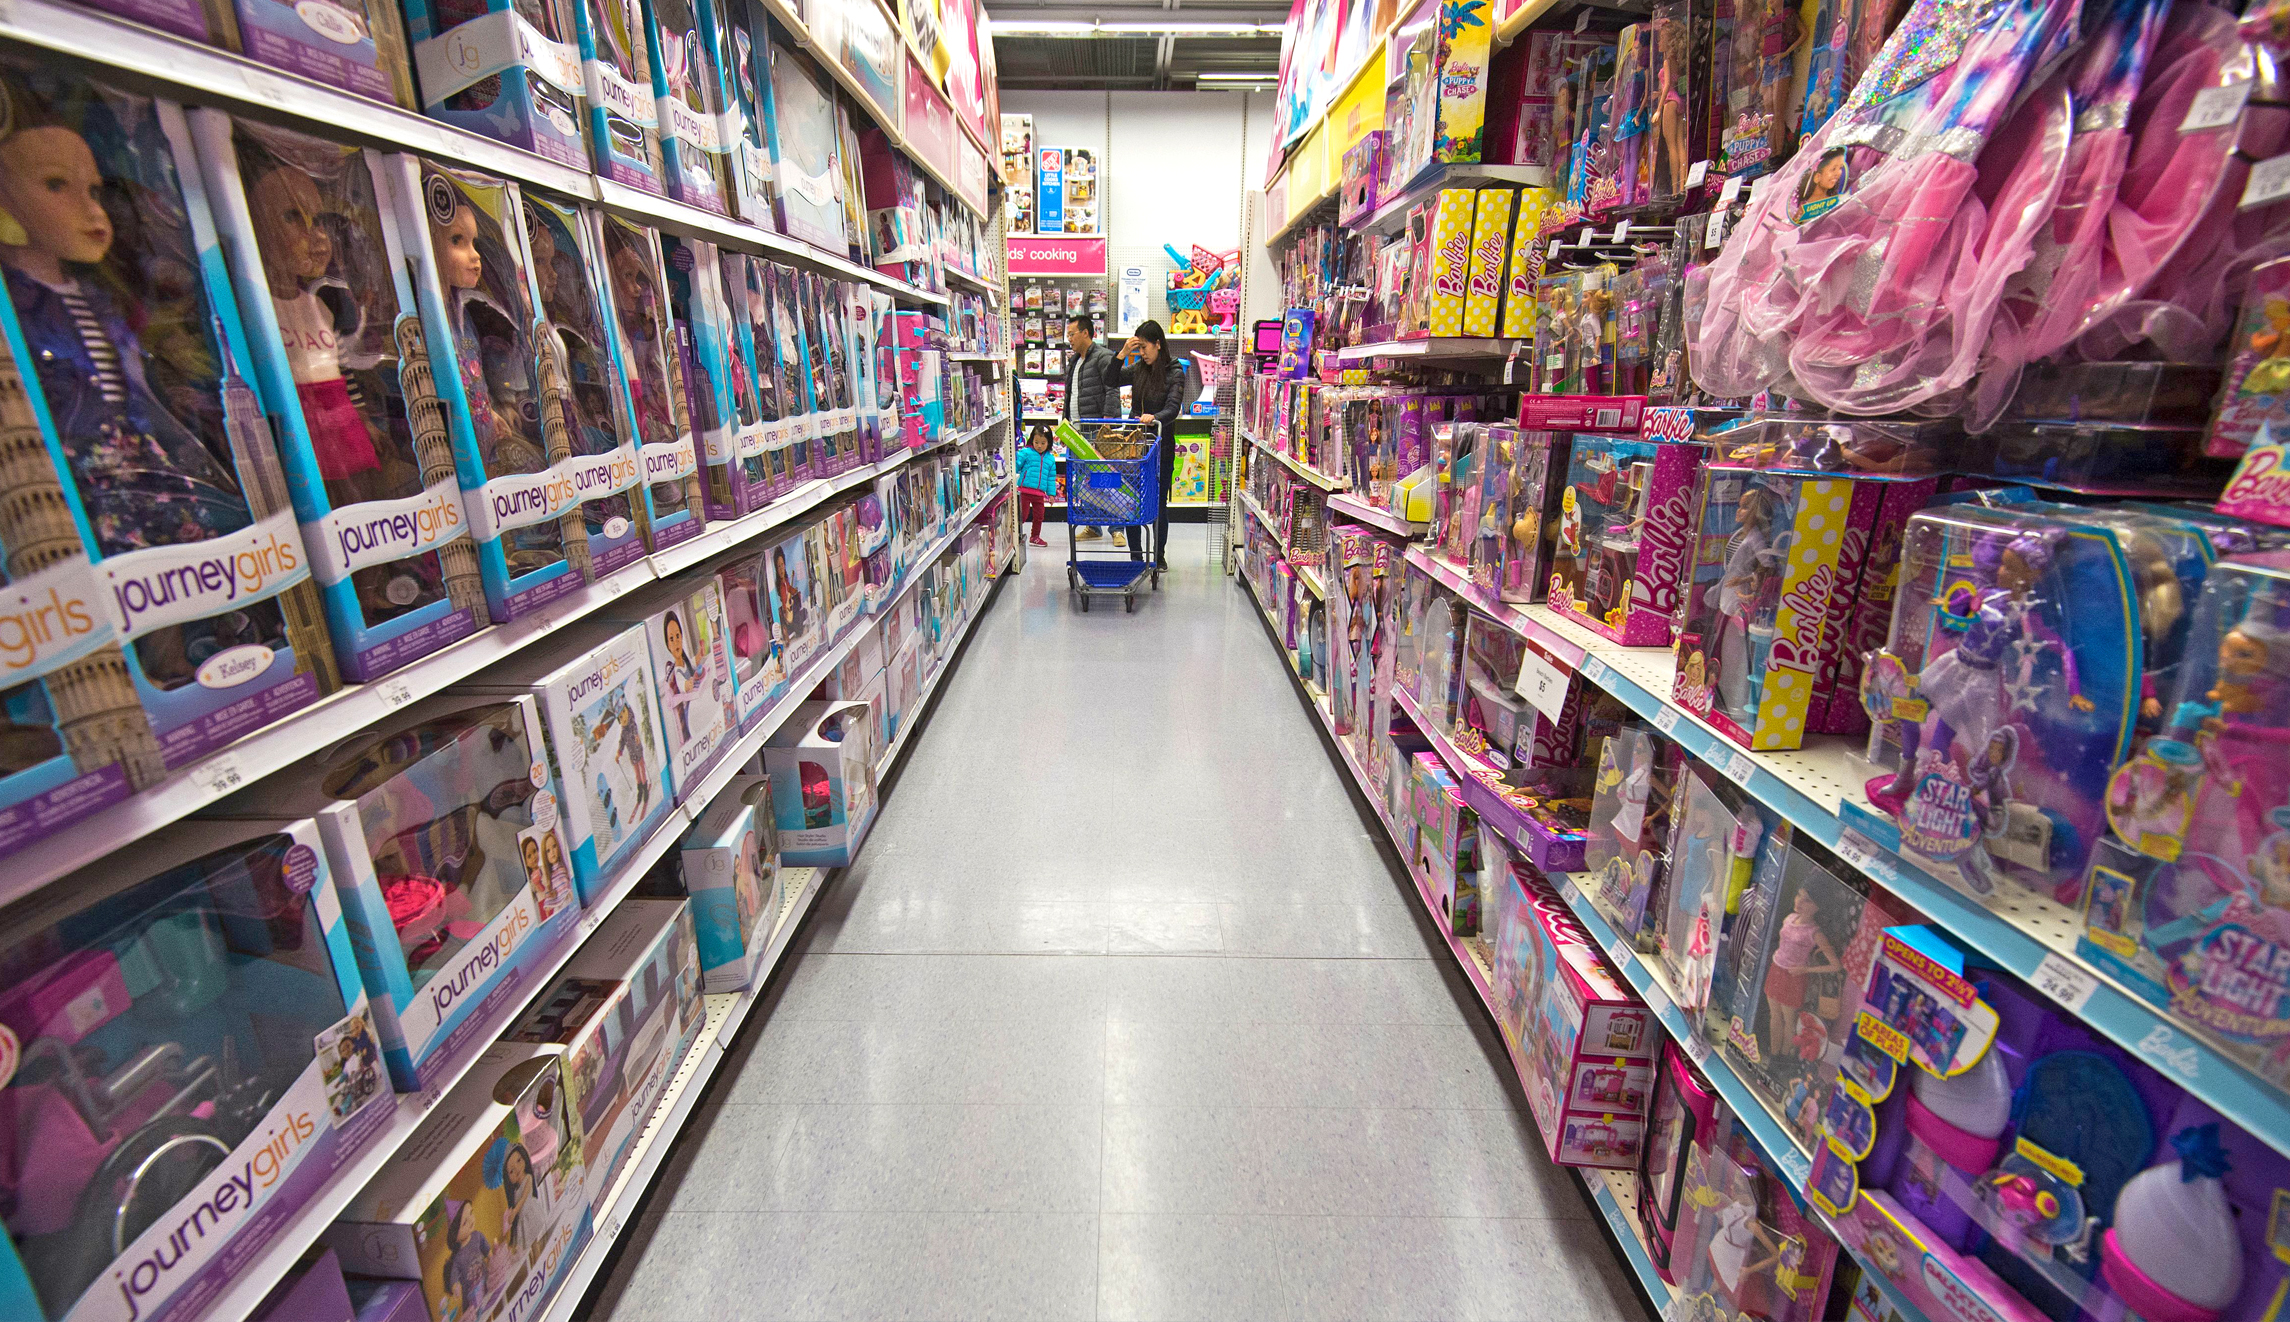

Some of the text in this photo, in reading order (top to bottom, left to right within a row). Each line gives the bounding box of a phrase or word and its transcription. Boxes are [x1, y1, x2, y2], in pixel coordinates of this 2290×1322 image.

[600, 74, 654, 120] journeygirls
[1447, 86, 1470, 96] CHASE
[1450, 77, 1470, 85] PUPPY
[671, 101, 718, 147] journeygirls
[1731, 154, 1761, 171] CHASE
[1734, 139, 1760, 153] PUPPY
[1807, 198, 1837, 212] LIGHT UP
[1007, 247, 1077, 264] ids' cooking
[1435, 231, 1468, 298] Barbie
[1469, 231, 1504, 299] Barbie
[280, 327, 335, 350] CIAO
[1641, 405, 1694, 442] Barbie
[575, 455, 636, 496] ourneygirls
[644, 444, 695, 481] journeygirls
[490, 471, 574, 529] journeygirls
[334, 494, 459, 567] journeygirls
[1628, 485, 1693, 619] Barbie
[108, 533, 297, 633] journeygirls
[1548, 573, 1576, 611] Barbie
[1767, 564, 1834, 674] Barbie
[218, 657, 256, 679] Kelsey
[567, 658, 621, 711] journeygirls
[741, 668, 776, 706] journeygirls
[1539, 680, 1546, 692] $5
[1673, 671, 1706, 712] Barbie
[682, 721, 724, 775] journeygirls
[1454, 717, 1482, 754] Barbie
[1704, 741, 1726, 766] Barbie
[1471, 769, 1516, 795] Barbie
[1925, 778, 1972, 812] STAR
[1917, 803, 1967, 839] LIGHT
[429, 905, 530, 1026] journeygirls
[1886, 938, 1926, 969] OPENS
[1928, 961, 1946, 980] TO
[2203, 964, 2289, 1015] LIGHT
[1728, 1018, 1759, 1061] Barbie
[1860, 1028, 1872, 1038] OF
[1864, 1015, 1905, 1046] 3 AREAS
[2138, 1024, 2199, 1078] Barbie
[423, 1089, 442, 1111] 29.99
[632, 1046, 673, 1127] journeygirls
[115, 1108, 316, 1322] journeygirls
